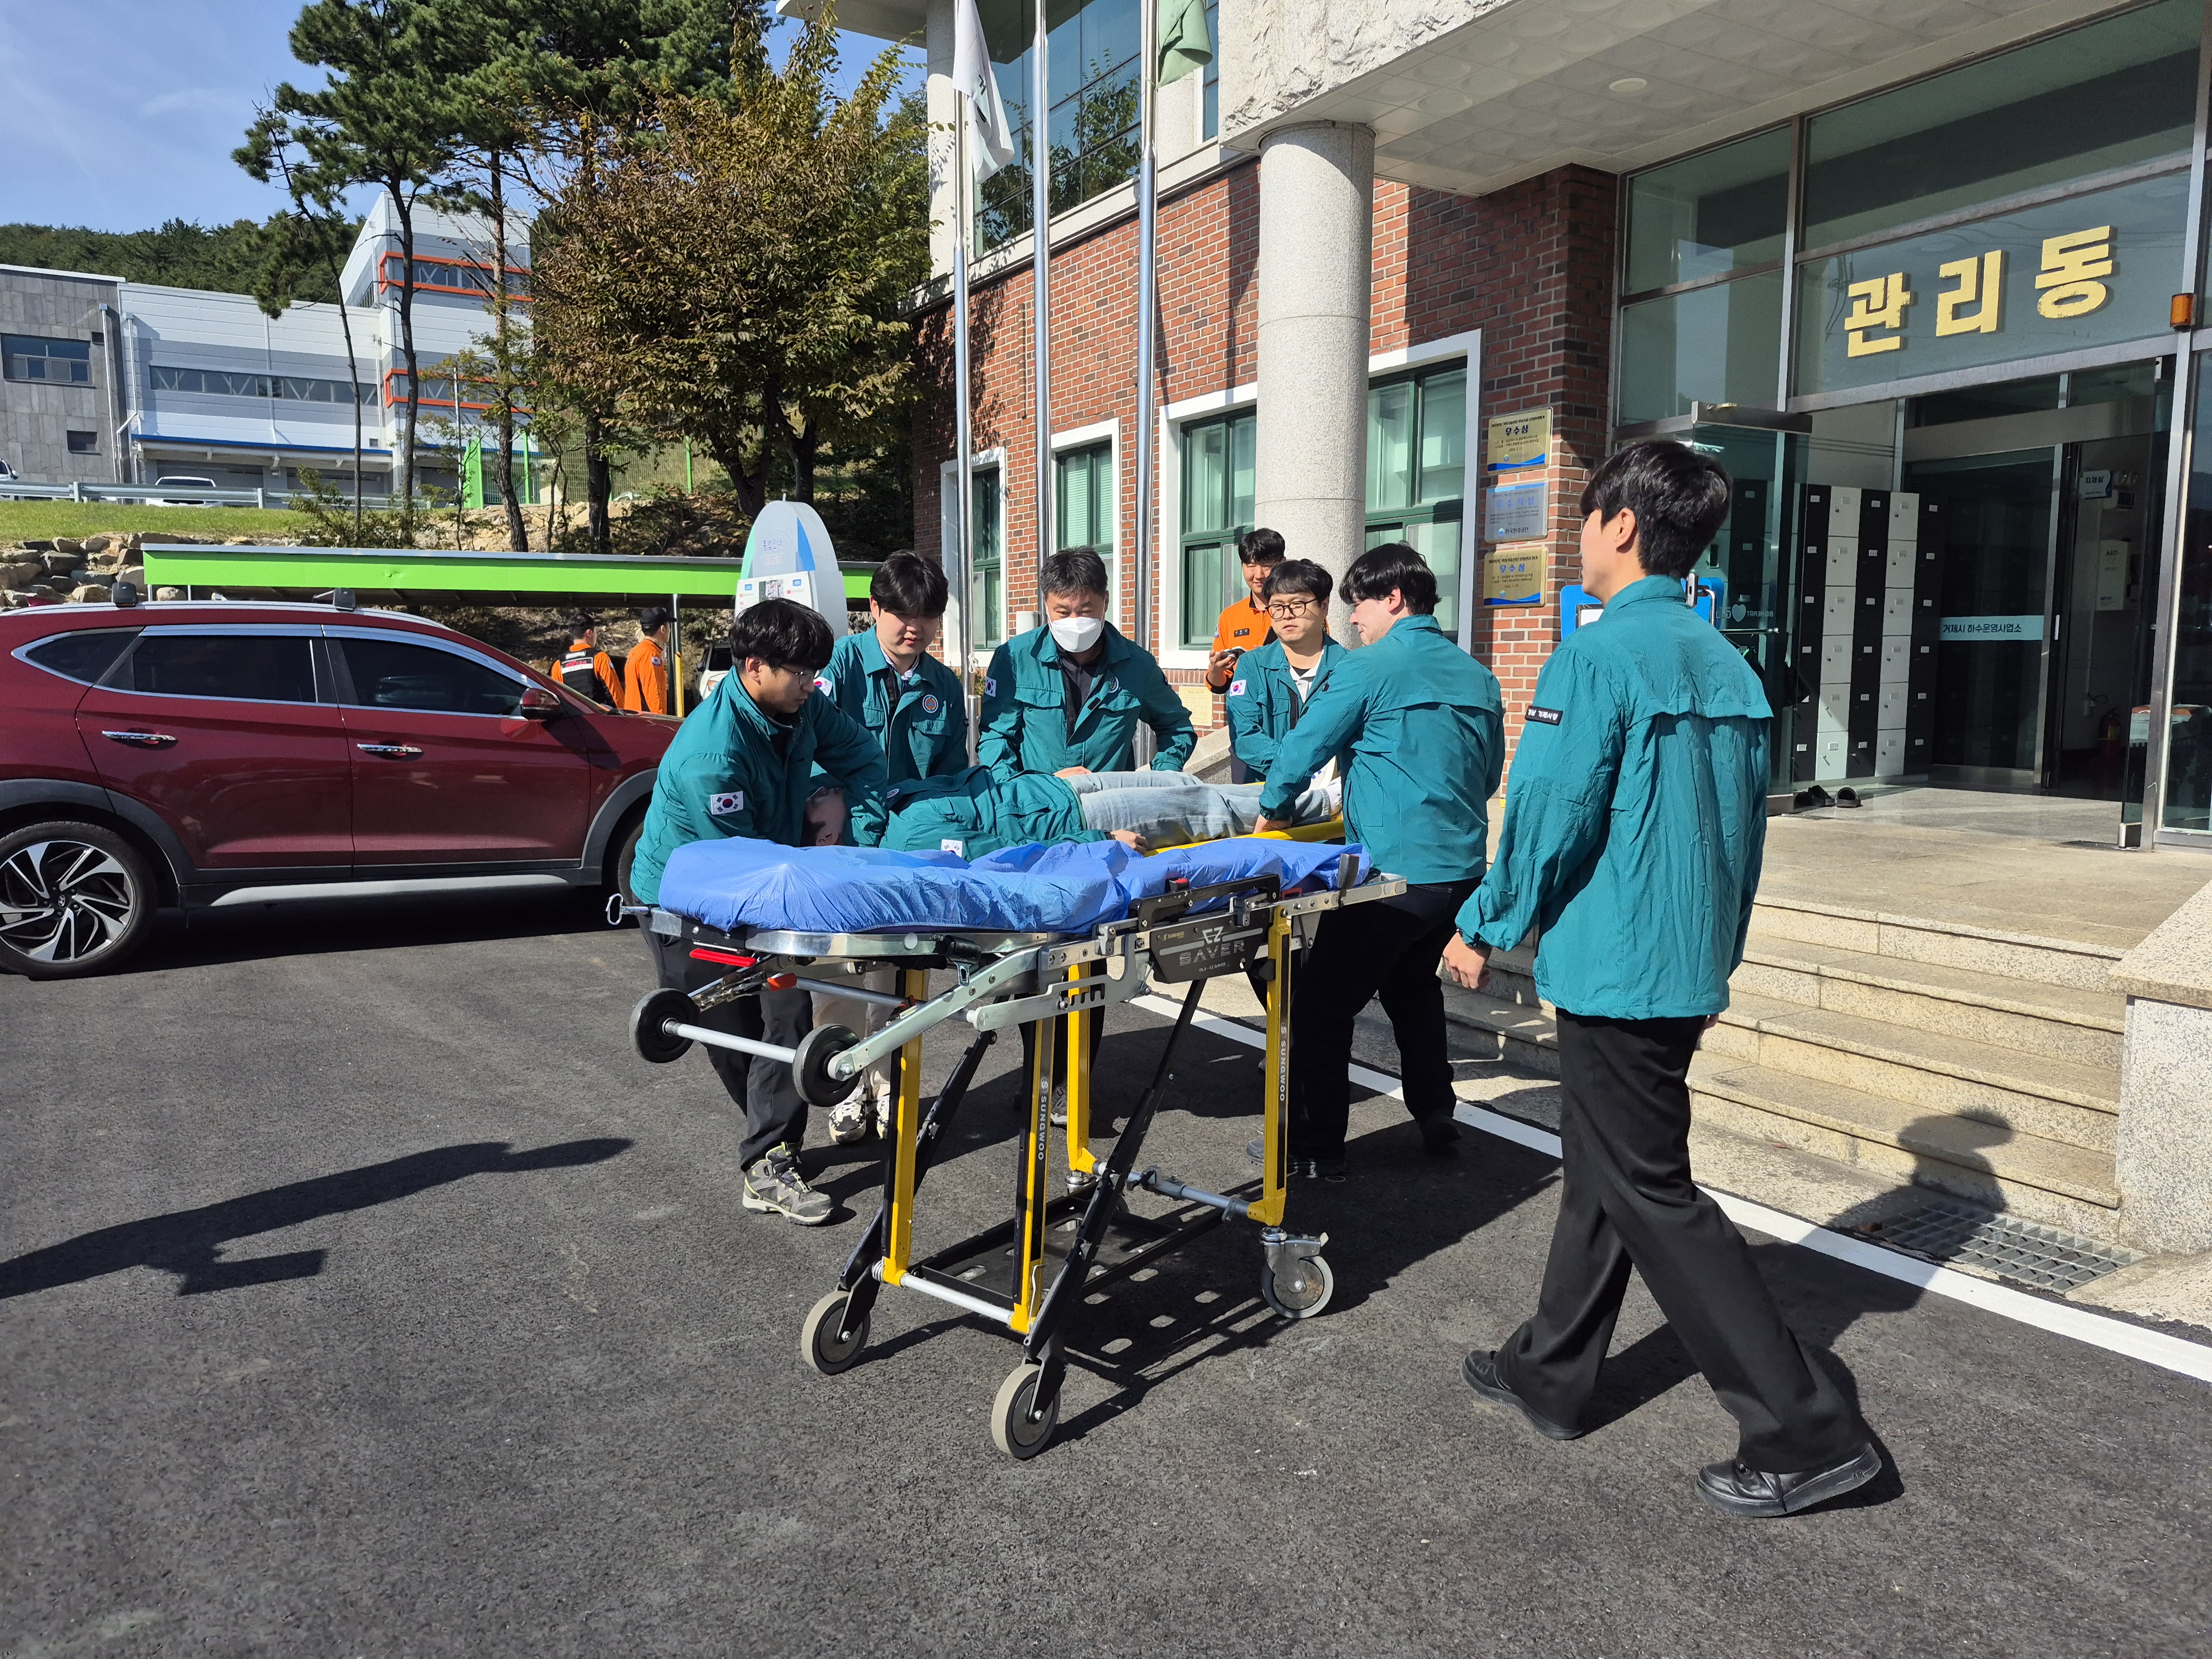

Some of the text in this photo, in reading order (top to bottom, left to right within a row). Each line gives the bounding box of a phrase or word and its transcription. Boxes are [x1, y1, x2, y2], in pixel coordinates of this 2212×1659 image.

[1844, 225, 2114, 358] 관리동
[1943, 623, 2022, 633] 거제시 하수운영사업소
[1179, 940, 1245, 966] SAVER
[1038, 1095, 1047, 1160] SUNGWOO
